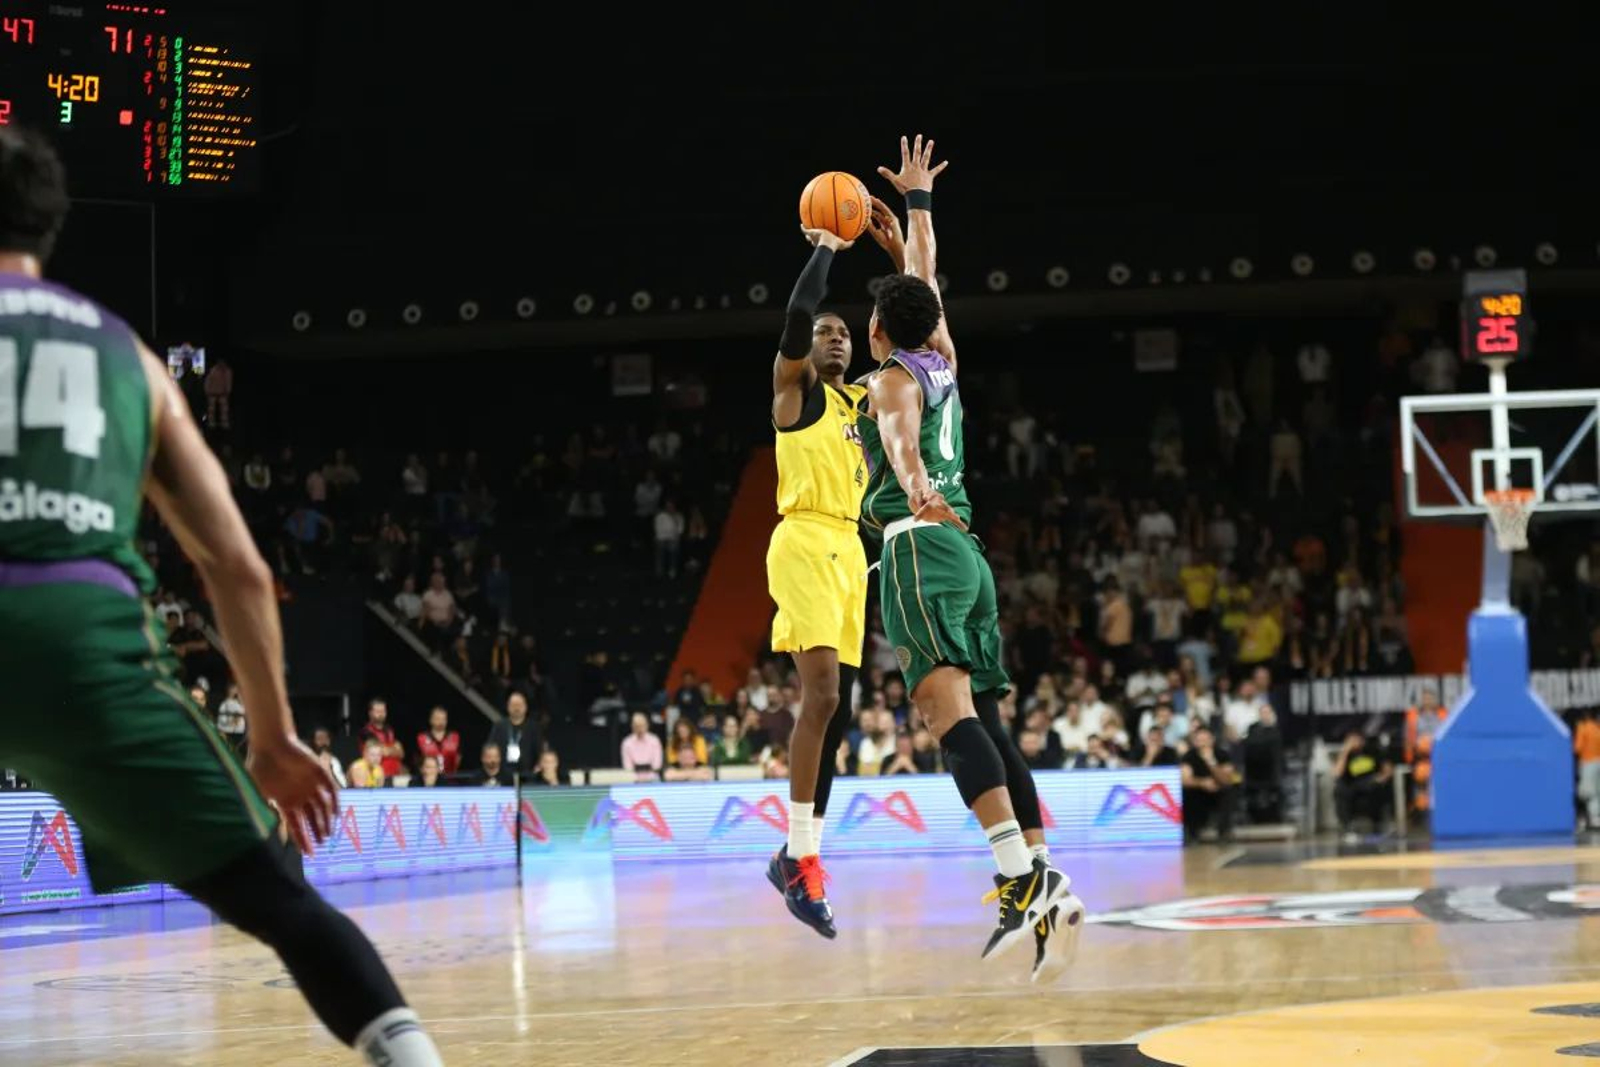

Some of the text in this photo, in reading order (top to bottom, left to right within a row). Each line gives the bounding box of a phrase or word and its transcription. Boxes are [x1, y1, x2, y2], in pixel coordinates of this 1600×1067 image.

[4, 18, 34, 44] 47
[105, 26, 133, 54] 71
[174, 36, 183, 49] 0
[48, 73, 100, 102] 4:20
[60, 101, 73, 123] 3
[1477, 317, 1518, 353] 25
[0, 478, 115, 534] álaga
